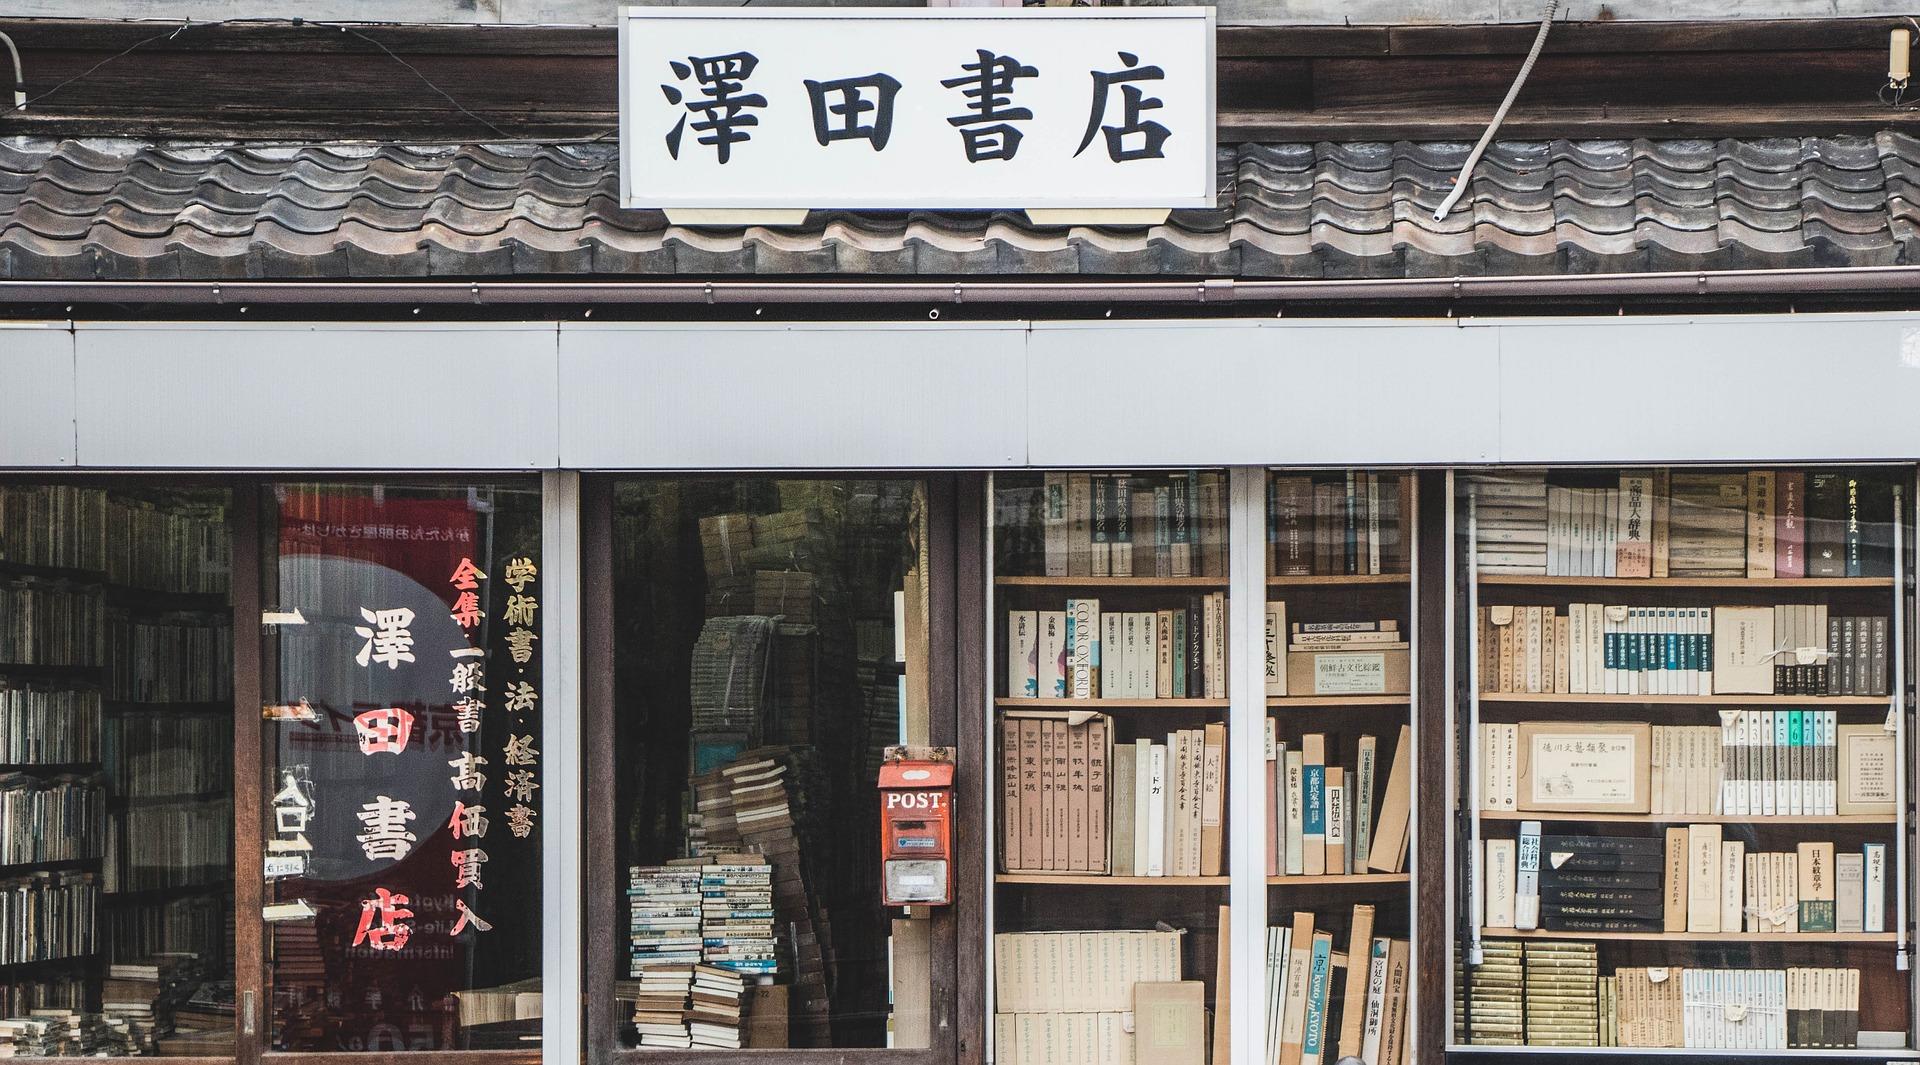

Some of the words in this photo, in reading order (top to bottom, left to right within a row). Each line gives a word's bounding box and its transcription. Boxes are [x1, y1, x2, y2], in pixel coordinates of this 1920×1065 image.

[660, 48, 1172, 165] 澤田書店
[1628, 485, 1641, 540] 商品大辞典
[1076, 602, 1089, 641] COLOR
[1076, 645, 1089, 697] OXFORD
[1792, 728, 1798, 741] 6
[352, 606, 416, 951] 澤田書店
[1024, 757, 1037, 792] 東京城
[1152, 776, 1161, 795] ドガ
[887, 793, 943, 809] POST
[1530, 837, 1539, 869] 社会科学
[1812, 849, 1822, 892] 日本紋章学
[1313, 954, 1327, 971] 京
[1373, 960, 1383, 995] 宮廷の庭
[1393, 961, 1402, 993] 人間国宝
[1308, 1012, 1320, 1046] KYOTO
